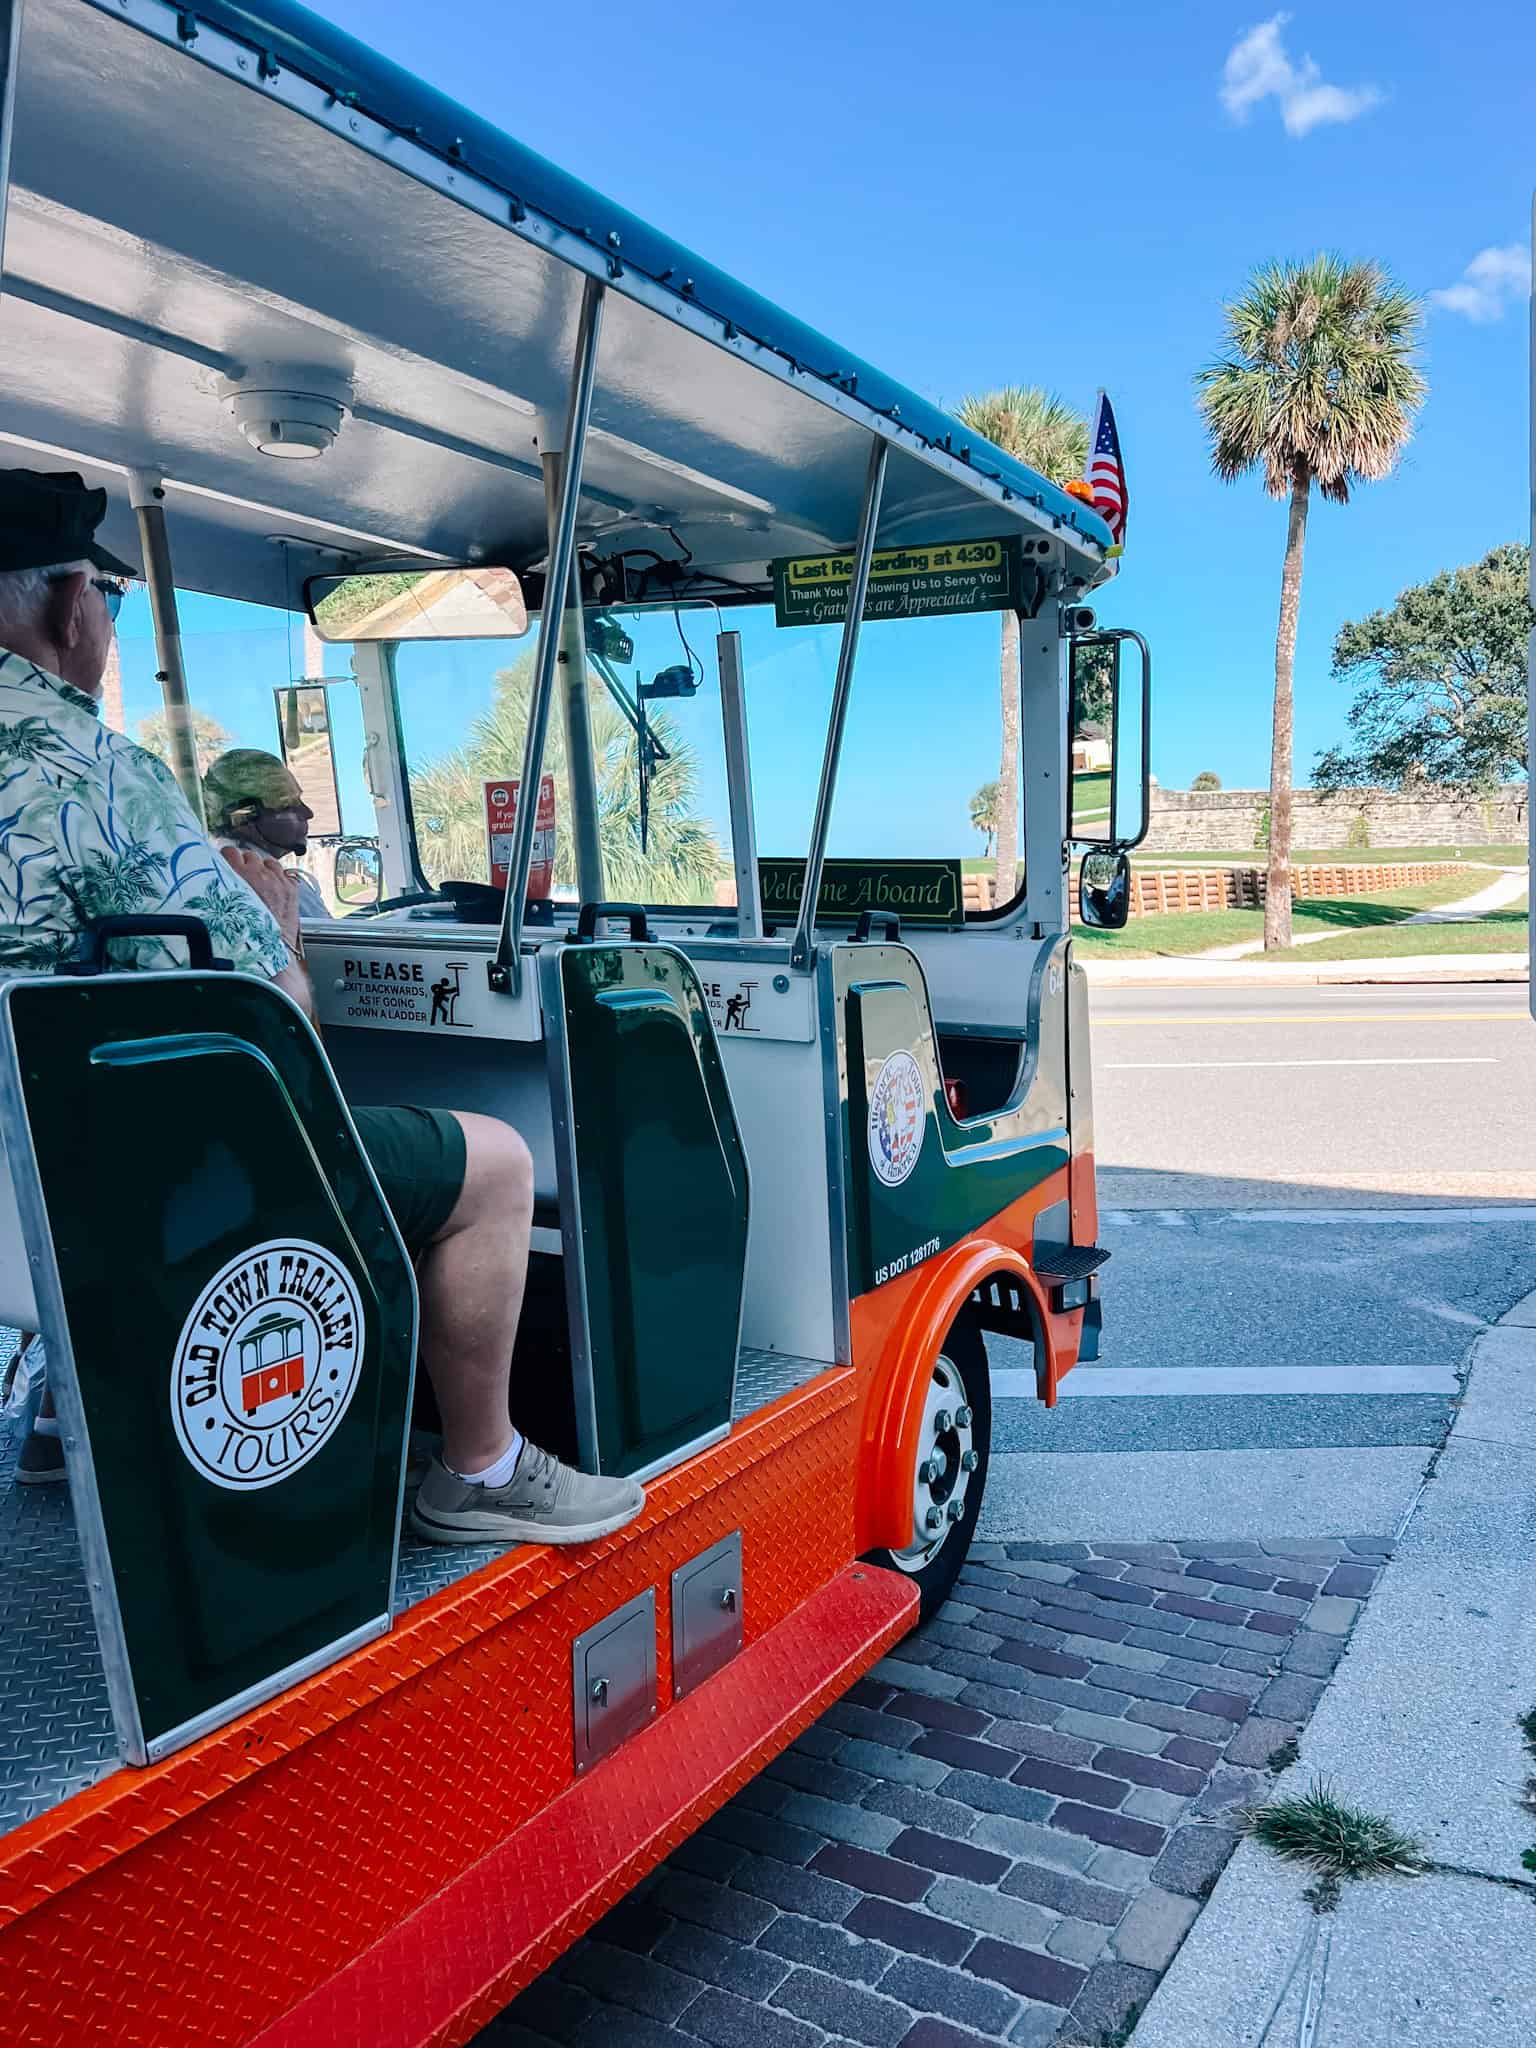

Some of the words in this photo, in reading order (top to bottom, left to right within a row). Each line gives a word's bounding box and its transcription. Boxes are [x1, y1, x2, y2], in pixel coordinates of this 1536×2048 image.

[793, 561, 828, 579] Last
[831, 551, 929, 575] Rearding
[933, 549, 953, 566] at
[956, 545, 996, 563] 4:30
[790, 587, 821, 600] Thank
[823, 586, 844, 598] You
[912, 578, 928, 590] Us
[929, 578, 942, 588] to
[944, 575, 977, 587] Serve
[979, 572, 1002, 583] You
[875, 599, 895, 612] are
[895, 586, 980, 615] Appreciated
[850, 873, 949, 906] Aboard
[344, 959, 425, 983] PLEASE
[343, 982, 363, 993] EXIT
[365, 983, 428, 998] BACKWARDS,
[358, 995, 370, 1005] AS
[372, 996, 381, 1006] IF
[382, 997, 416, 1009] GOING
[347, 1007, 379, 1019] DOWN
[380, 1009, 388, 1019] A
[388, 1010, 427, 1022] LADDER
[875, 1265, 889, 1285] US
[889, 1253, 909, 1278] DOT
[910, 1236, 940, 1266] 1281776
[200, 1259, 270, 1338] TOWN
[278, 1255, 353, 1352] TROLLEY
[185, 1343, 220, 1408] OLD
[216, 1386, 335, 1474] TOURS
